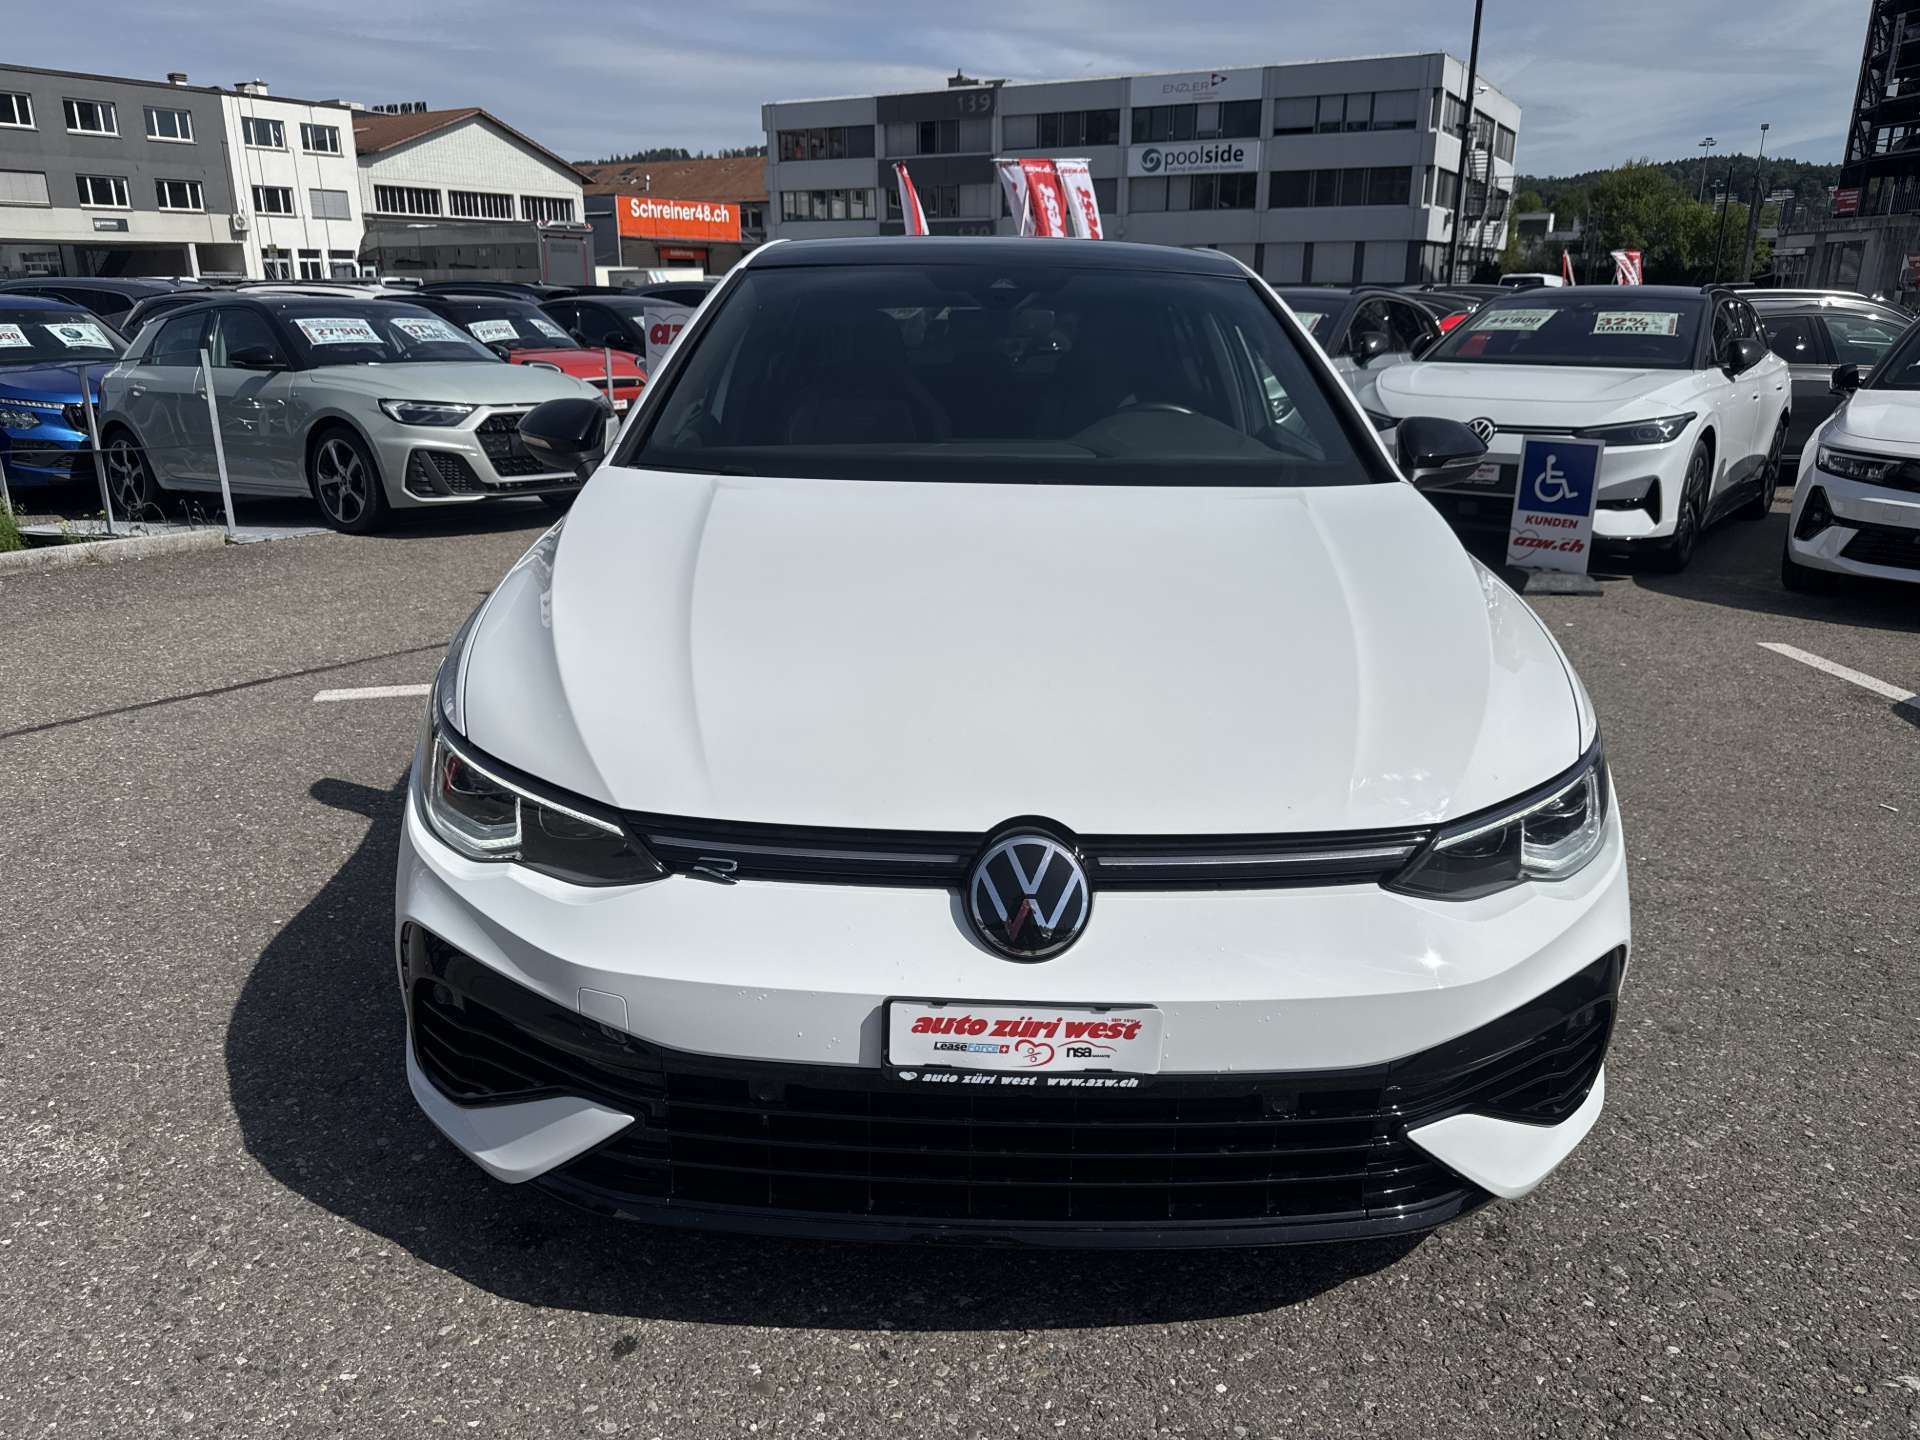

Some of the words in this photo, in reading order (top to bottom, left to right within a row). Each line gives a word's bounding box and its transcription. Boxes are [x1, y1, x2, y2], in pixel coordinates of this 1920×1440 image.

[1162, 81, 1210, 94] ENZLER
[958, 94, 991, 113] 139
[1164, 144, 1244, 173] poolside
[631, 198, 729, 223] Schreiner48.ch
[1599, 316, 1649, 327] 32%
[1525, 515, 1579, 529] KUNDEN
[1513, 536, 1585, 552] azw.ch
[911, 1014, 987, 1037] auto
[989, 1015, 1060, 1039] züri
[1065, 1018, 1143, 1041] west
[1066, 1046, 1092, 1058] nsa
[922, 1072, 959, 1083] auto
[961, 1073, 998, 1085] züri
[1000, 1075, 1038, 1086] west
[1047, 1077, 1139, 1088] www.azw.ch
